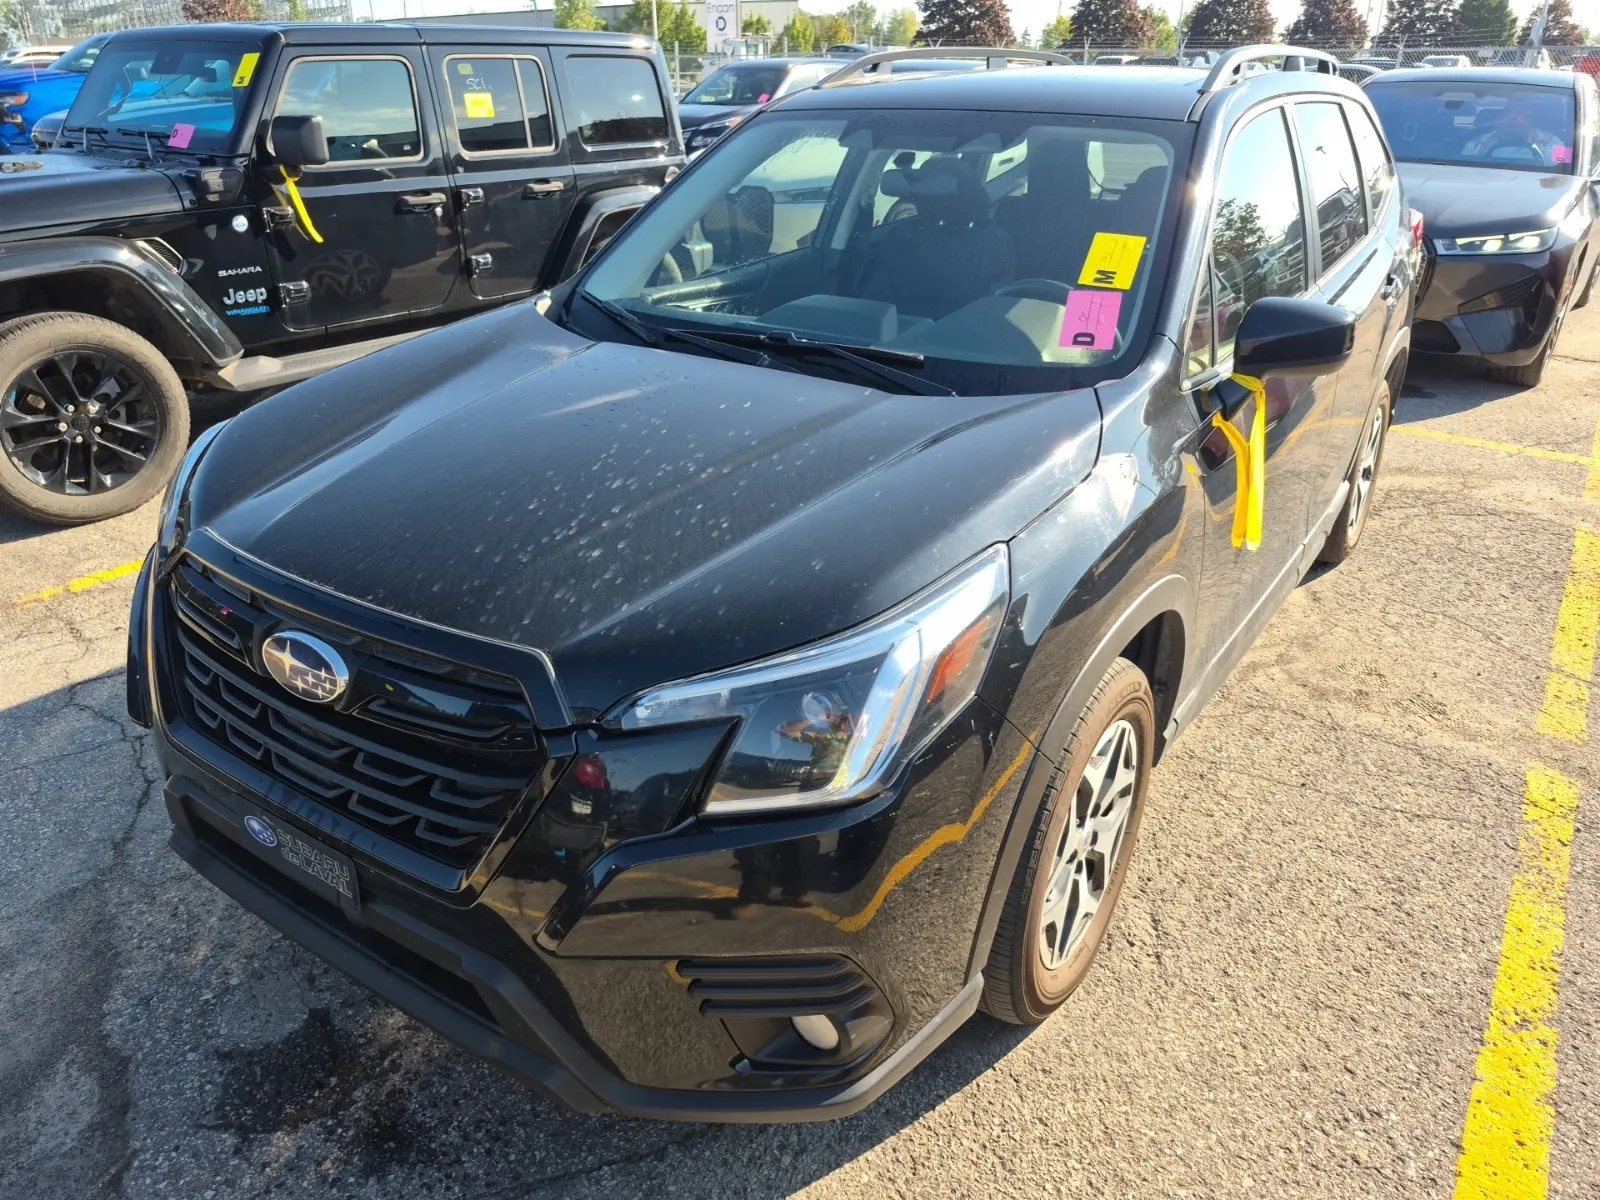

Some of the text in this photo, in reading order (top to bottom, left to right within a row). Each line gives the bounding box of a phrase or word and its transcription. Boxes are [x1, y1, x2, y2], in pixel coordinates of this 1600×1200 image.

[218, 266, 262, 277] SAHARA
[1093, 269, 1117, 285] M
[223, 287, 267, 305] Jeep
[1072, 332, 1096, 347] D
[276, 828, 350, 881] SUBARU
